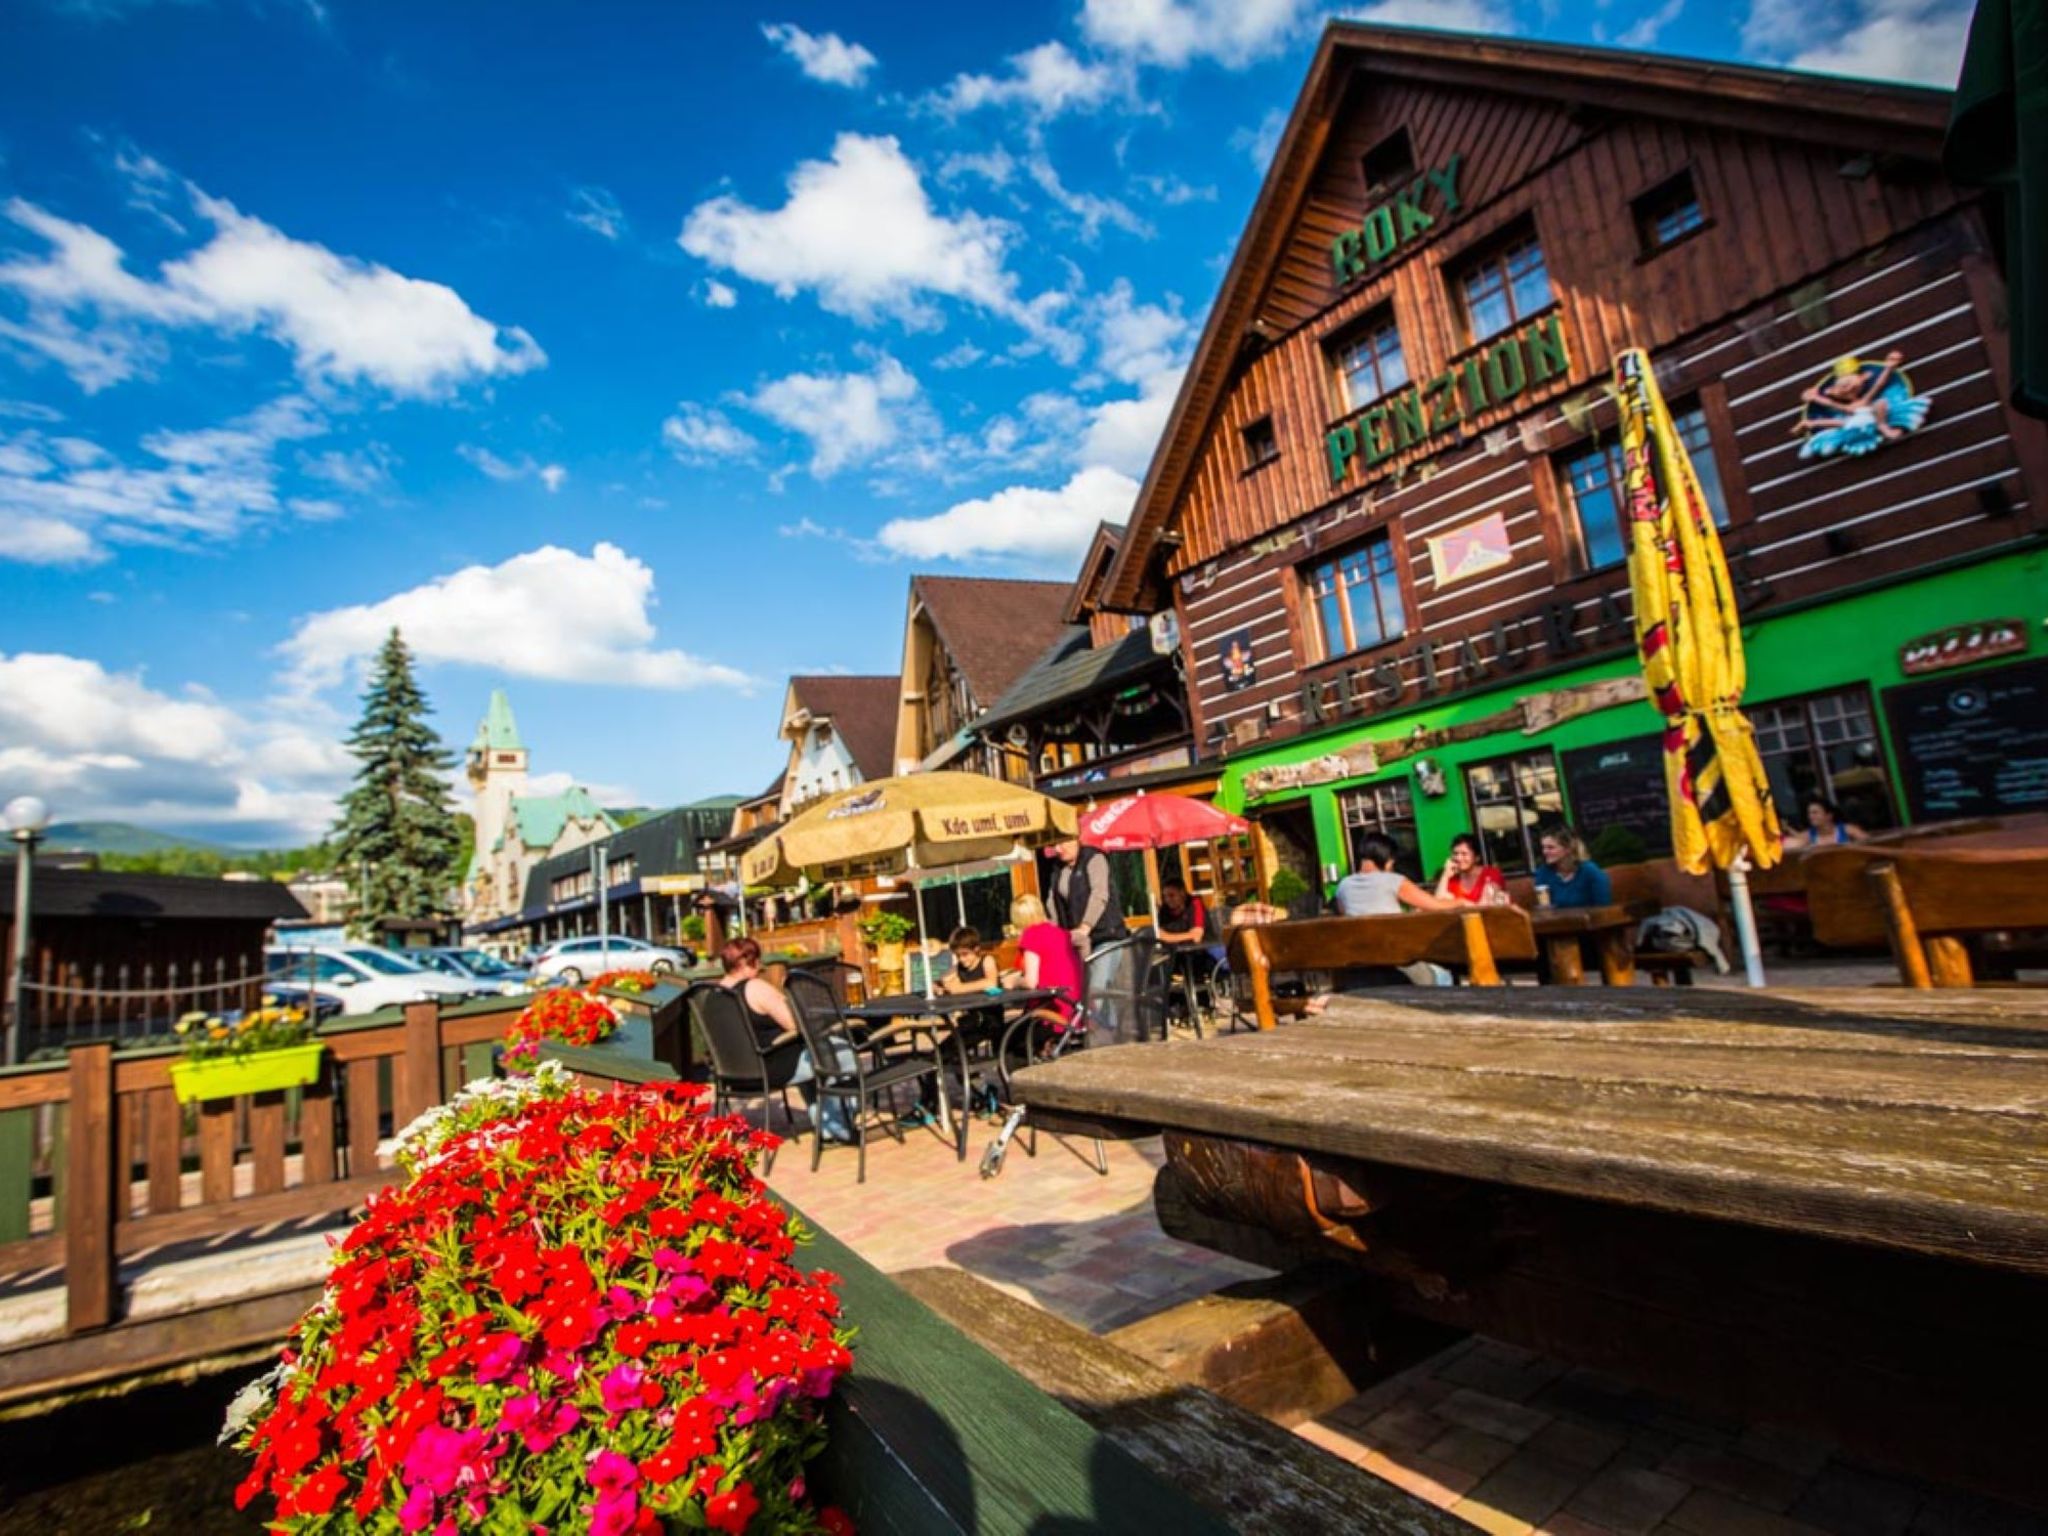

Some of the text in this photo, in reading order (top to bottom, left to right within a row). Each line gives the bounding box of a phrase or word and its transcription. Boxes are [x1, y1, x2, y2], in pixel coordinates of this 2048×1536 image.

[1332, 153, 1461, 285] ROKY
[1326, 311, 1569, 480] PENZION
[942, 817, 968, 835] Kdo
